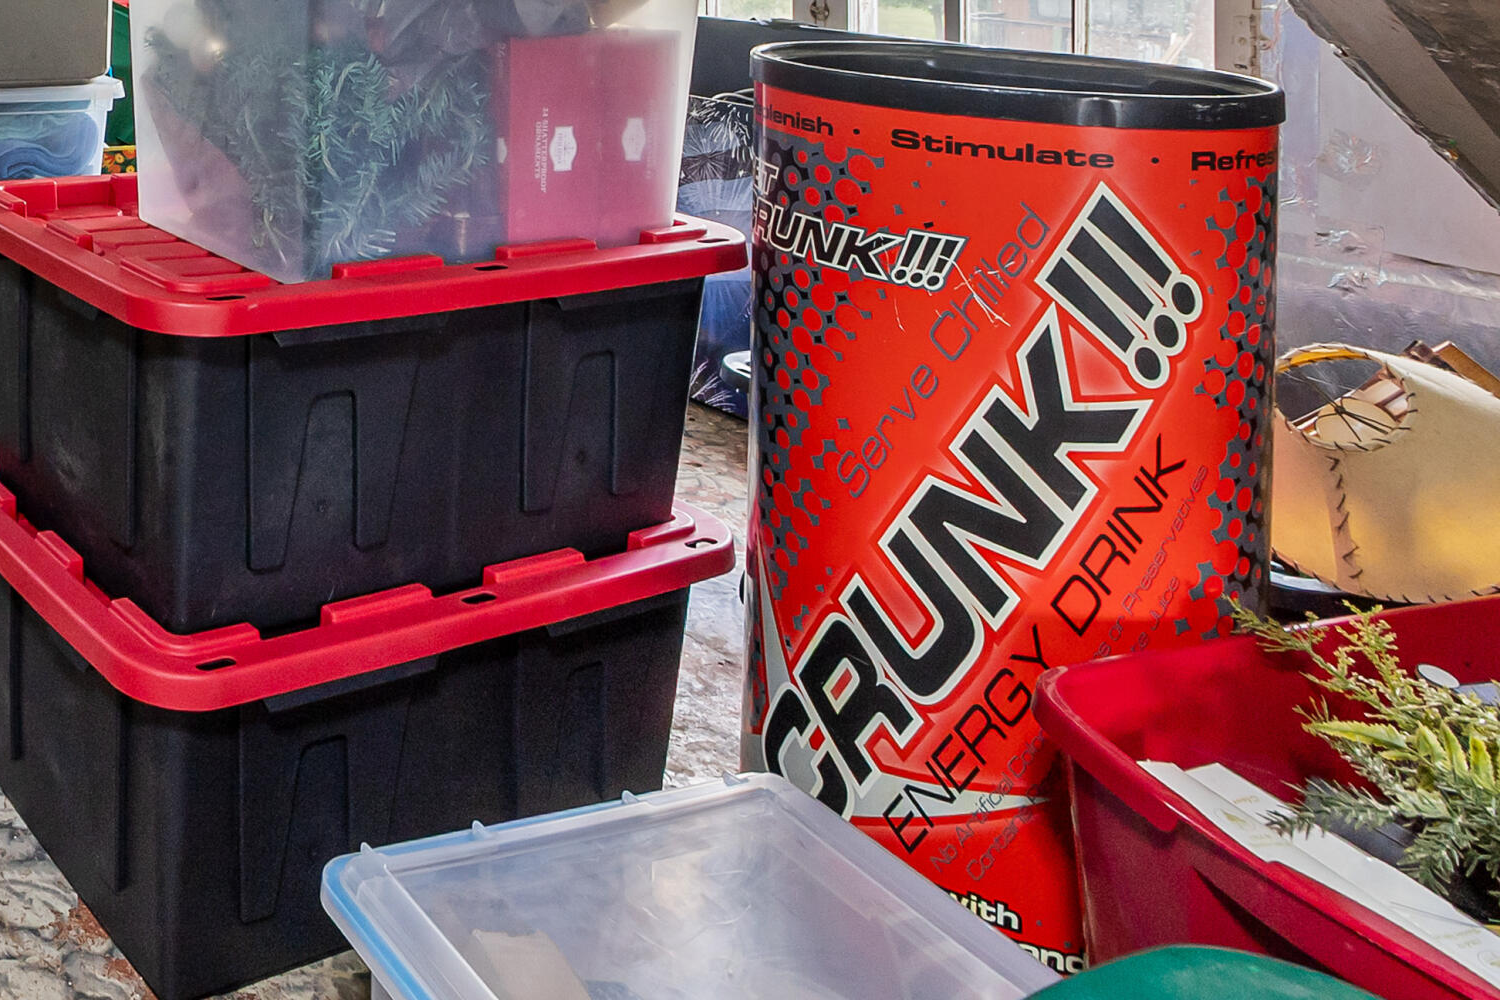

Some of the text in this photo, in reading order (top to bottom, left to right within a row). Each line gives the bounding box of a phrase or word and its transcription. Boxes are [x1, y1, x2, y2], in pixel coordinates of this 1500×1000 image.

[891, 128, 1115, 168] Stimulate
[837, 201, 1051, 499] Serve Chilled
[762, 181, 1203, 821] CRUNK!!!
[1122, 464, 1209, 616] Preservatives
[883, 434, 1186, 854] ENERGY DRINK
[930, 844, 959, 873] No
[955, 770, 1013, 848] Artificial
